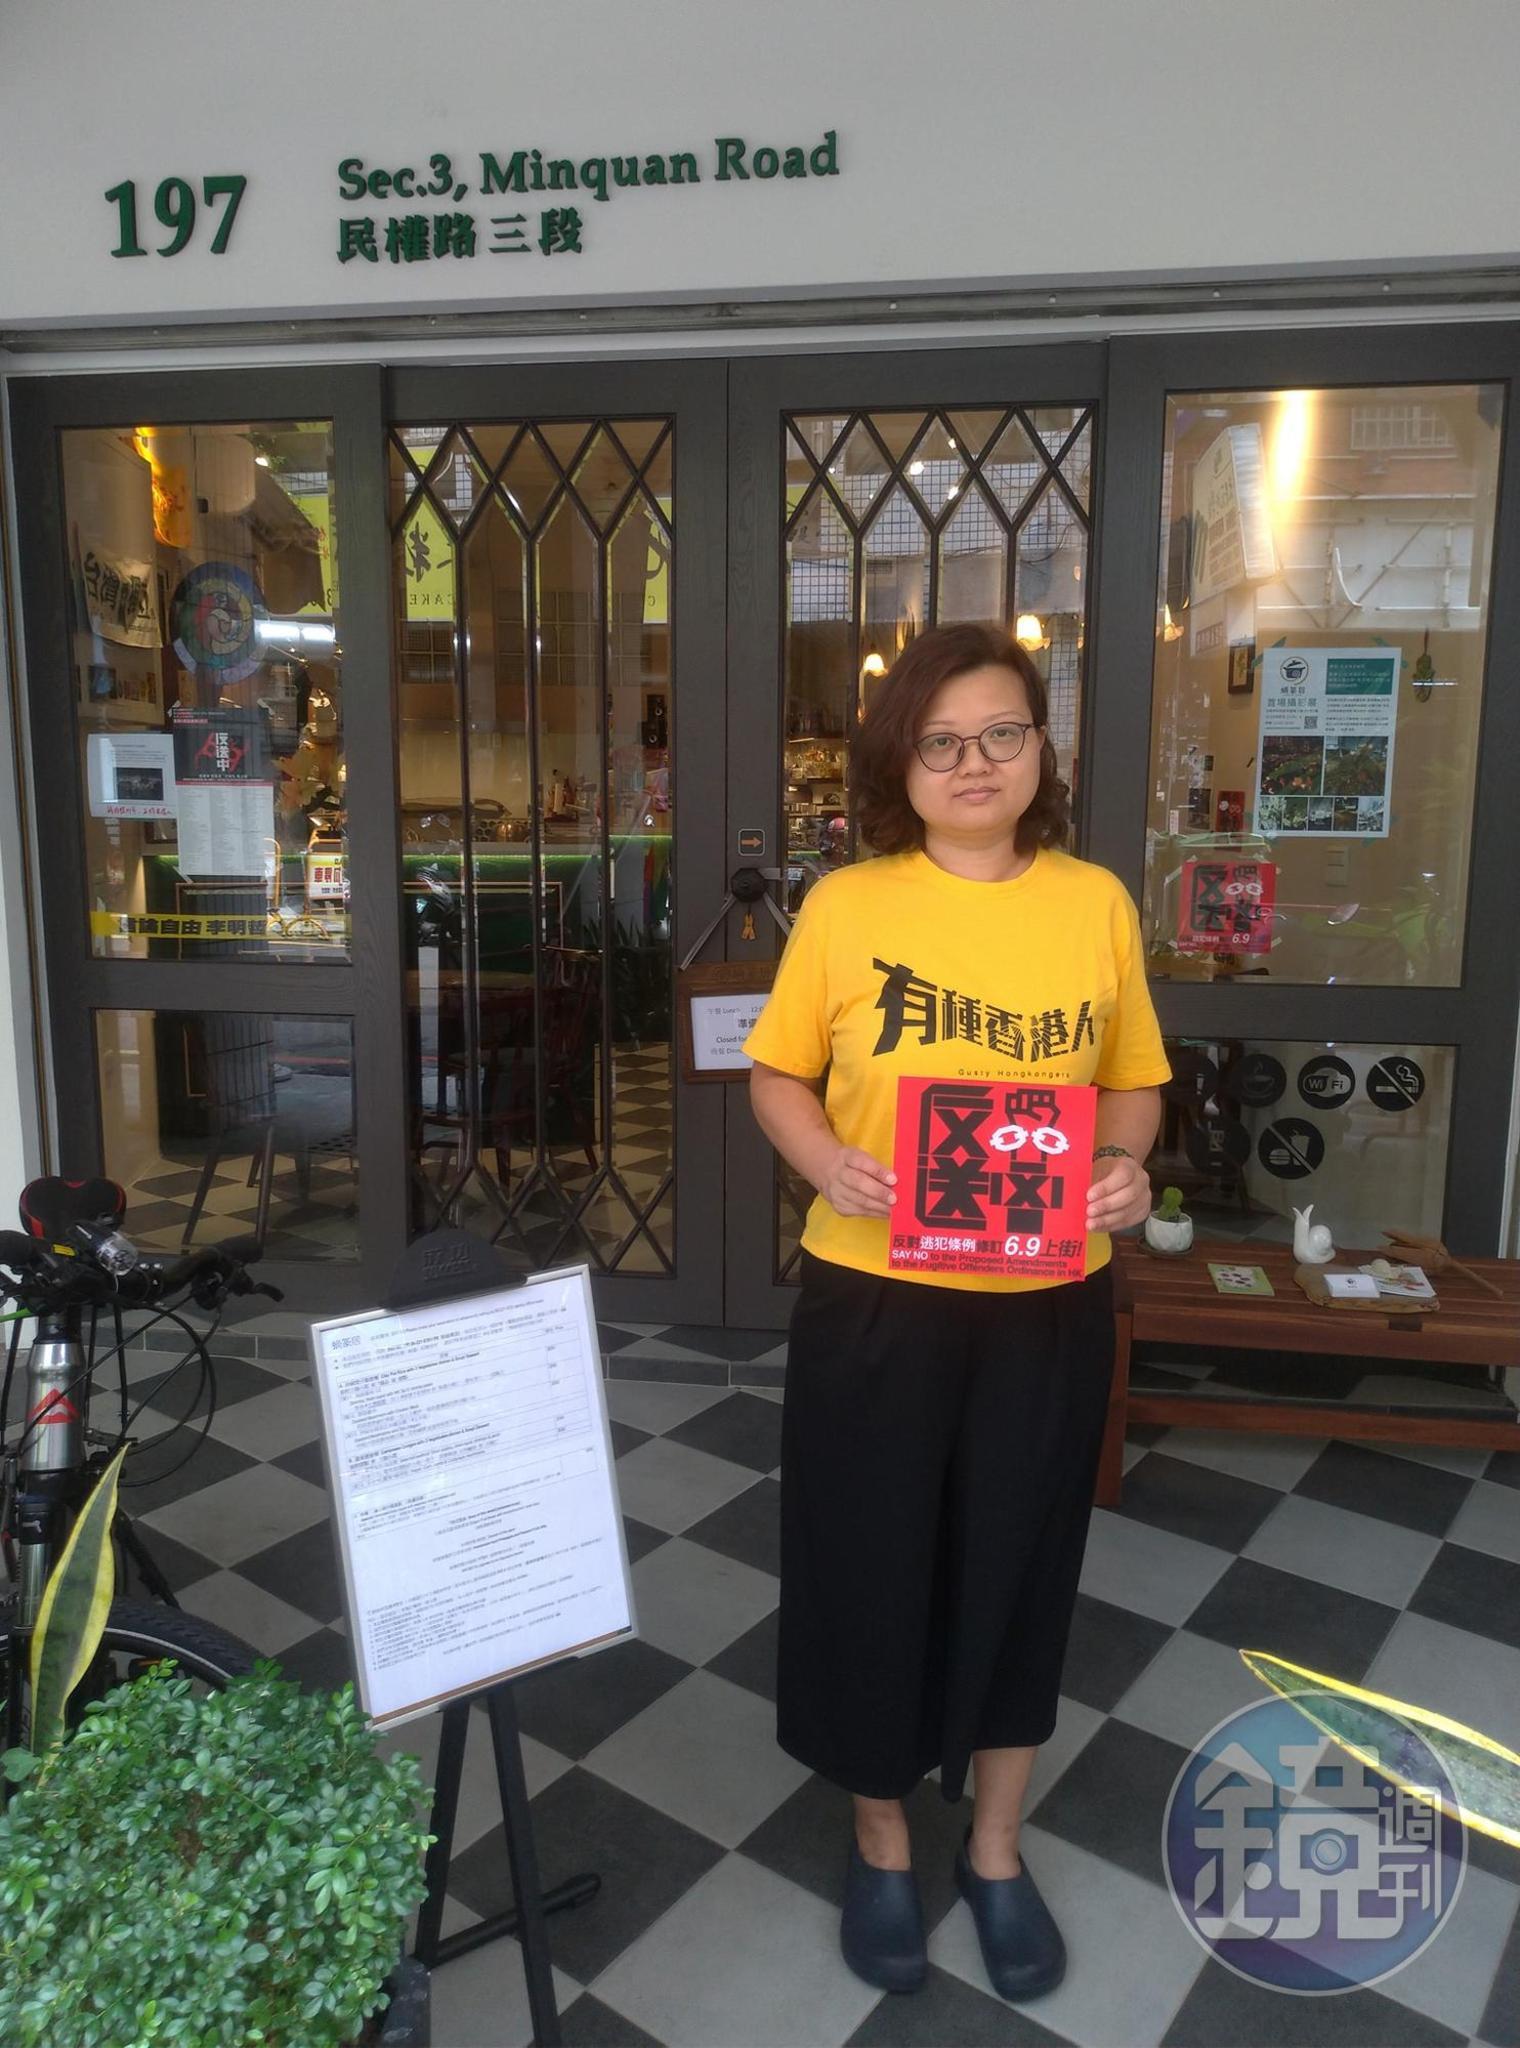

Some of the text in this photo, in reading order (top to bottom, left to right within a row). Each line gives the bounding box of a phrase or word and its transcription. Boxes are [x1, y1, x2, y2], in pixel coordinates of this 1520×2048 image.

[337, 130, 840, 202] Sec.3, Minquan Road
[104, 175, 248, 259] 197
[336, 206, 584, 265] 民權路三段
[215, 732, 230, 772] 反送中
[1232, 933, 1250, 944] 6.9
[872, 957, 1095, 1063] 有種香港人
[957, 1068, 1070, 1080] Gusty Hongkongers
[891, 1250, 912, 1259] SAY
[913, 1251, 928, 1260] NO
[941, 1253, 957, 1261] the
[959, 1254, 1004, 1266] Proposed
[1006, 1257, 1068, 1267] Amendments
[1004, 1235, 1041, 1257] 6.9
[920, 1261, 957, 1272] Fugitive
[959, 1262, 1005, 1273] Offenders
[1007, 1265, 1056, 1275] Ordinance
